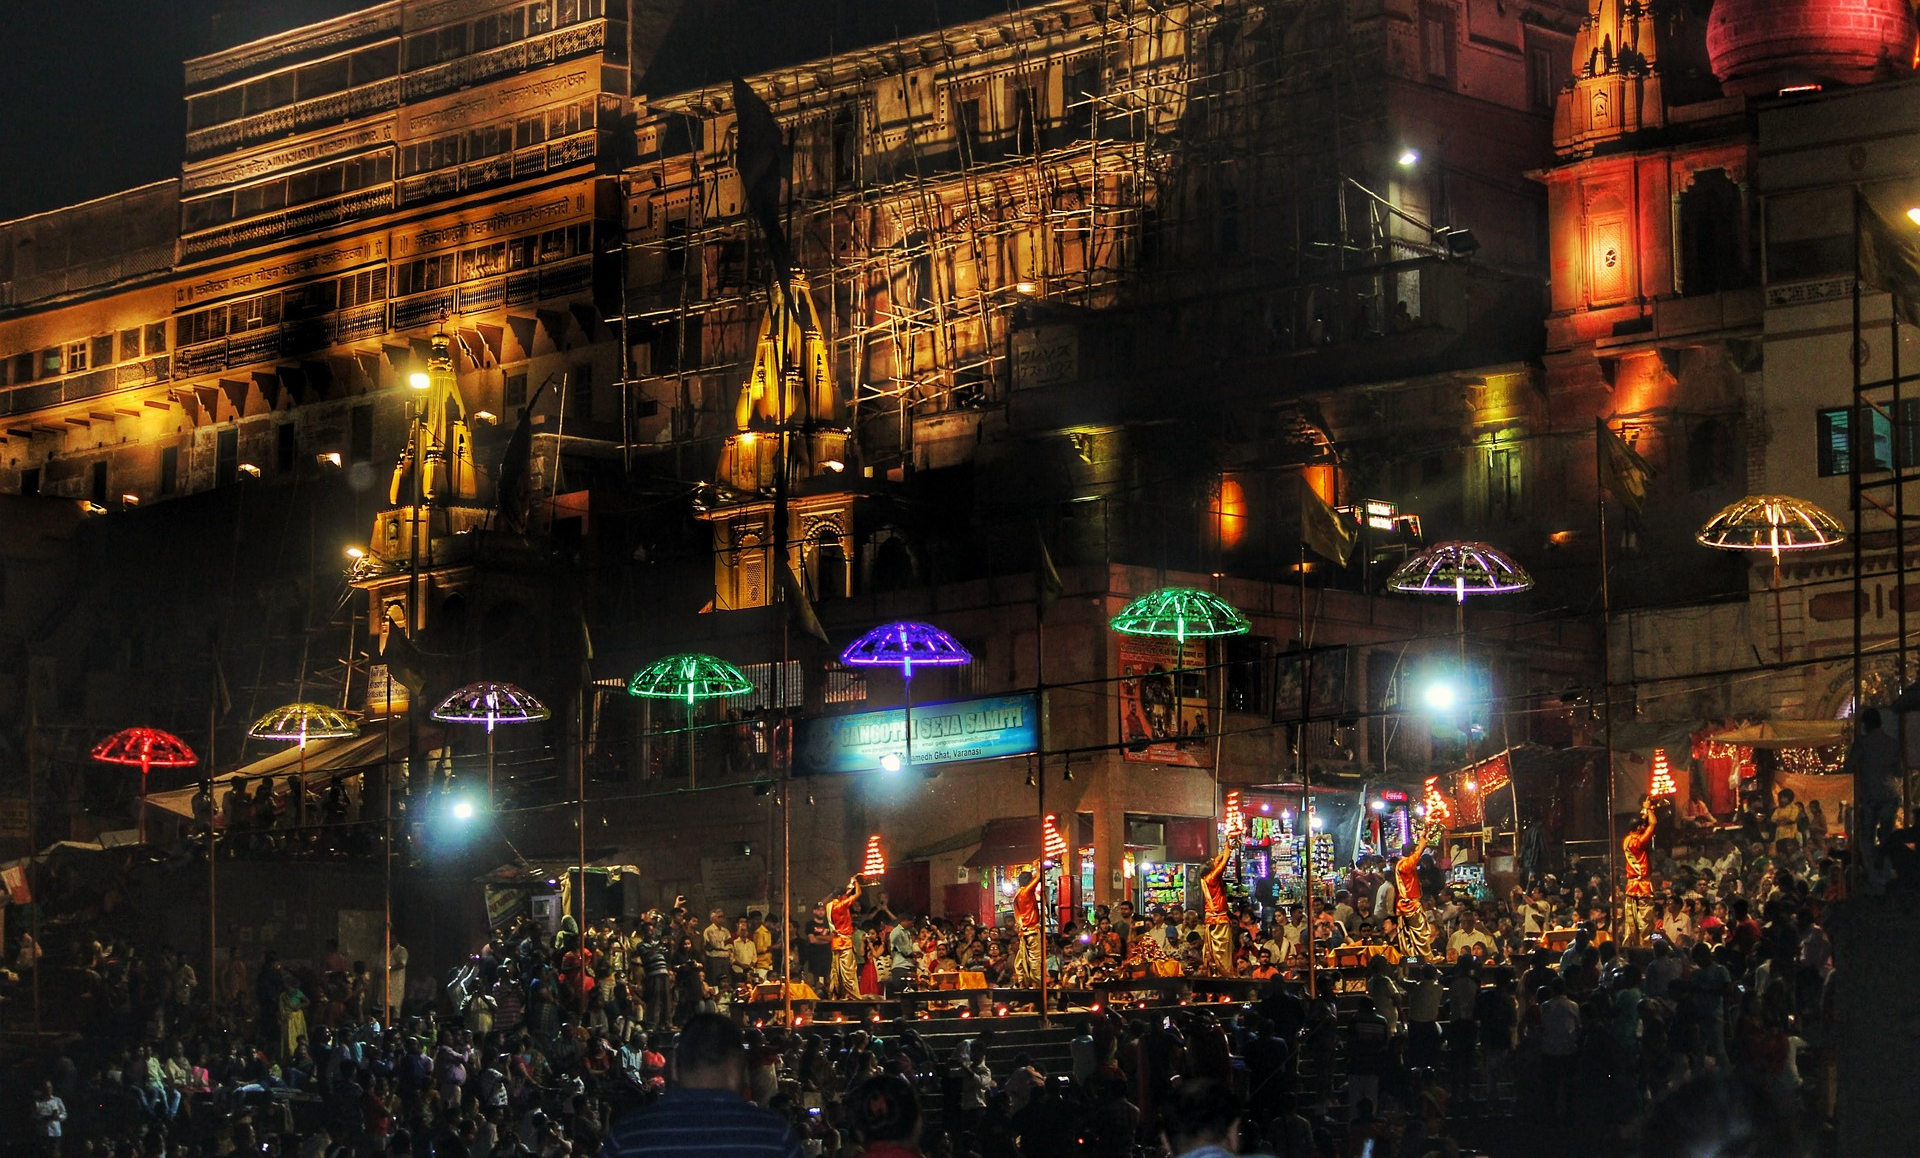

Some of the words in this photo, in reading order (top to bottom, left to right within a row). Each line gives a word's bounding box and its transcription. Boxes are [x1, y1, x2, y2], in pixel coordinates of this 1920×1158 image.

[920, 714, 963, 739] SEVA
[965, 706, 1024, 735] SAMITI
[952, 747, 982, 757] Varanasi
